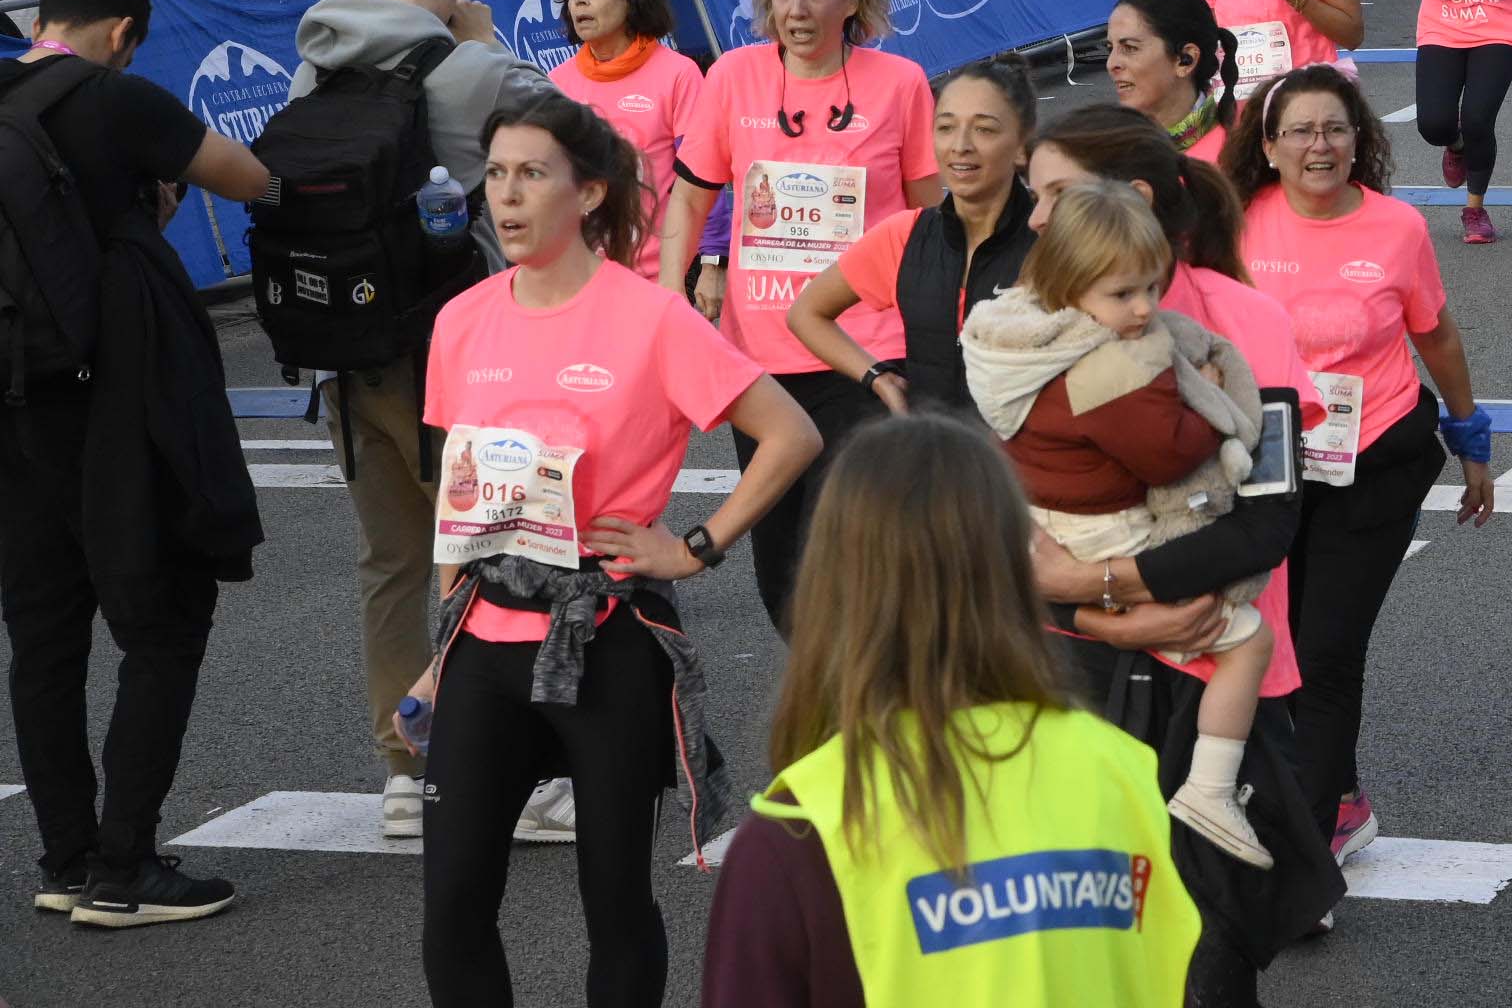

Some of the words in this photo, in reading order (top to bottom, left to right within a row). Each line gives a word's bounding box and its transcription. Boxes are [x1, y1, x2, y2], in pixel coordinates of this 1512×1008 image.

[1441, 4, 1487, 20] SUMA
[531, 30, 561, 43] CENTRAL
[1237, 53, 1264, 66] 016
[212, 88, 251, 105] CENTRAL
[252, 81, 289, 100] LECHERA
[740, 116, 778, 129] OYSH
[779, 180, 825, 193] ASTURIANA
[780, 206, 822, 223] 016
[789, 226, 809, 237] 936
[753, 238, 785, 247] CARRERA
[785, 240, 797, 248] DE
[797, 241, 808, 249] LA
[808, 242, 832, 250] MUJER
[750, 253, 784, 264] OYSHO
[813, 256, 838, 265] Santa
[1250, 260, 1300, 274] OYSHO
[466, 367, 513, 385] OYSHO
[483, 449, 529, 465] ASTURIANA
[1309, 464, 1345, 477] Santander
[482, 483, 527, 504] 016
[485, 506, 524, 522] 18172
[450, 524, 488, 534] CARRERA
[503, 522, 516, 531] LA
[517, 521, 543, 533] MUJER
[545, 526, 563, 537] 2023
[446, 540, 492, 554] OYSHO
[527, 540, 568, 557] Santander
